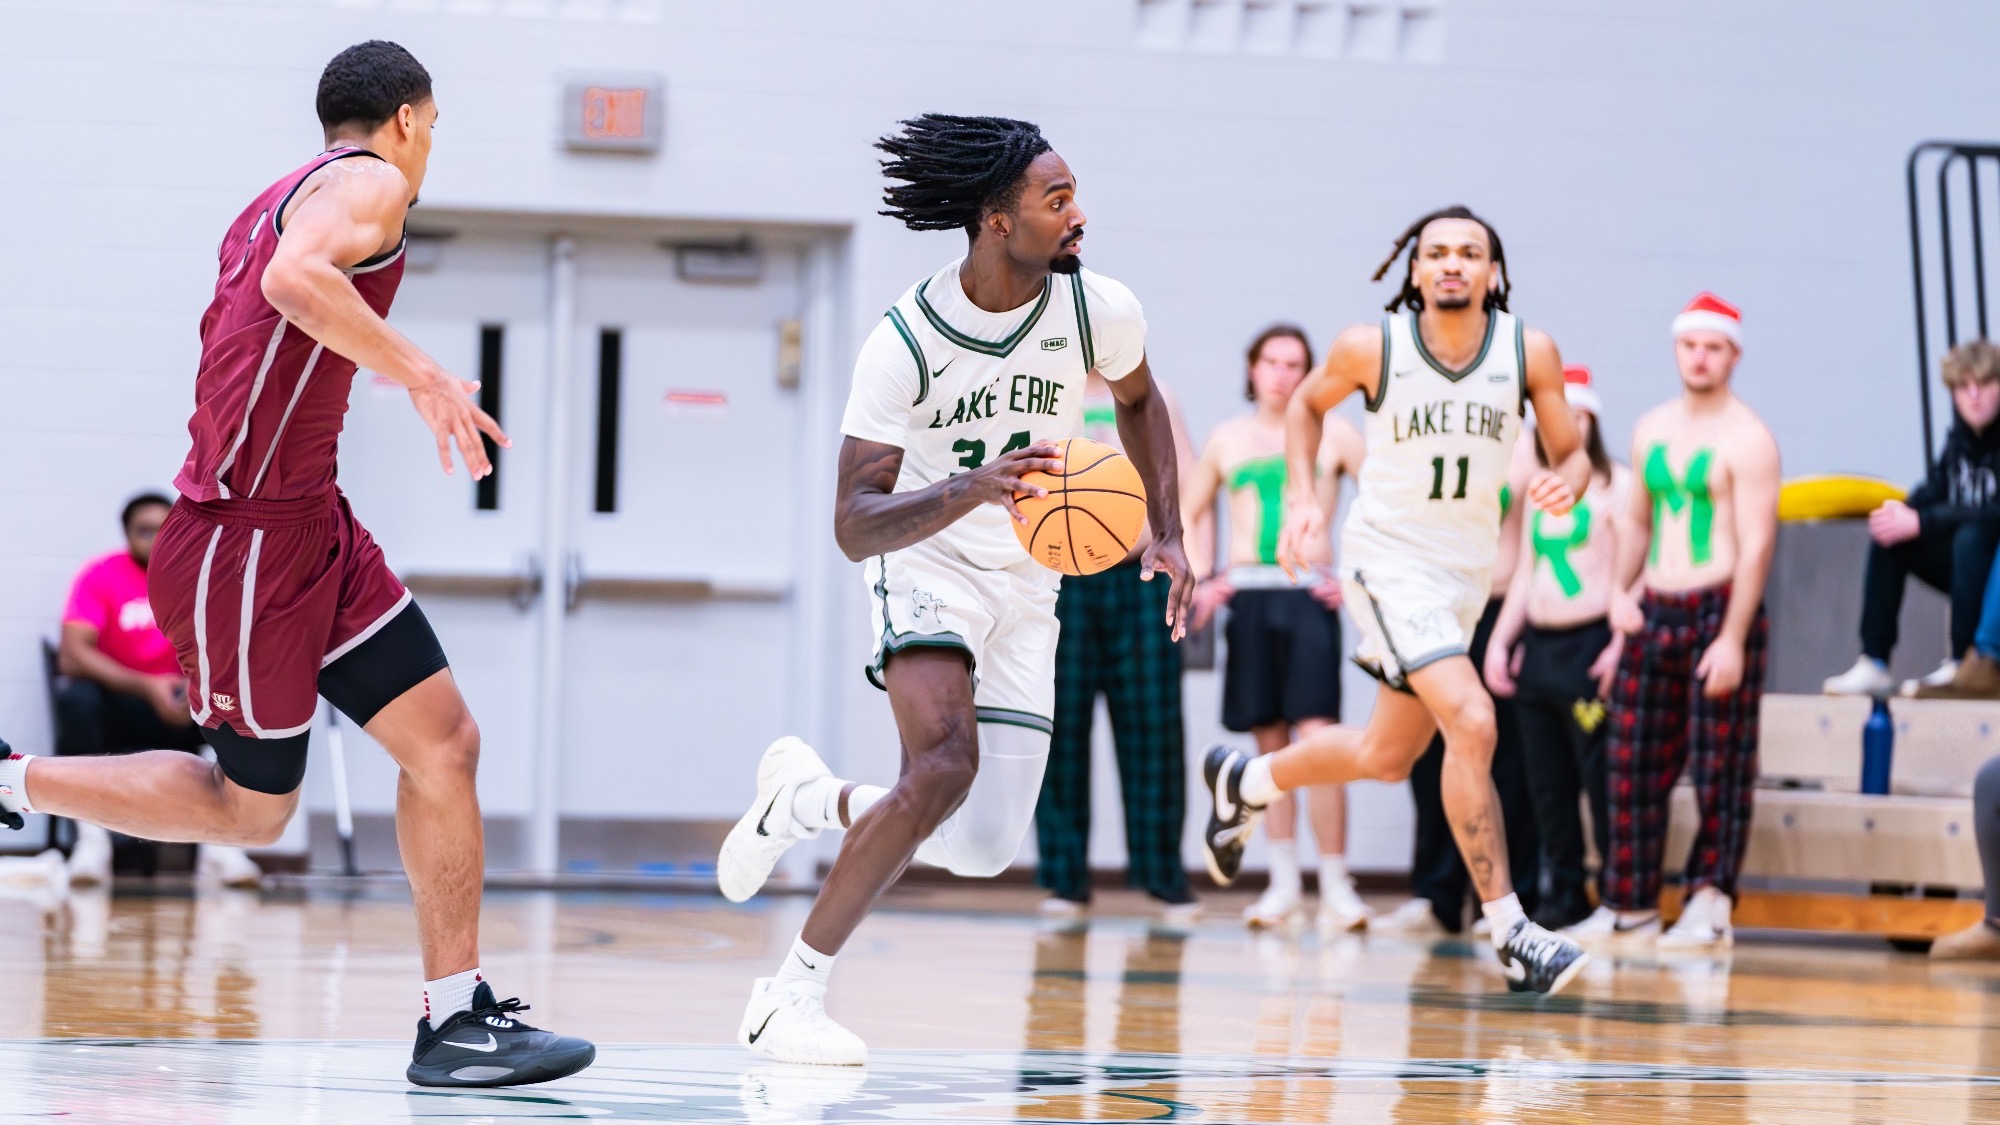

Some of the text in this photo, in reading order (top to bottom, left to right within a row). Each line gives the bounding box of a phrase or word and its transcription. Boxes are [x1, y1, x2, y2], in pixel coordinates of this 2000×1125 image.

[928, 374, 1064, 429] LAKE ERIE
[1393, 399, 1507, 443] LAKE ERIE
[1428, 455, 1469, 500] 11
[1644, 441, 1715, 567] M
[1532, 500, 1591, 598] R
